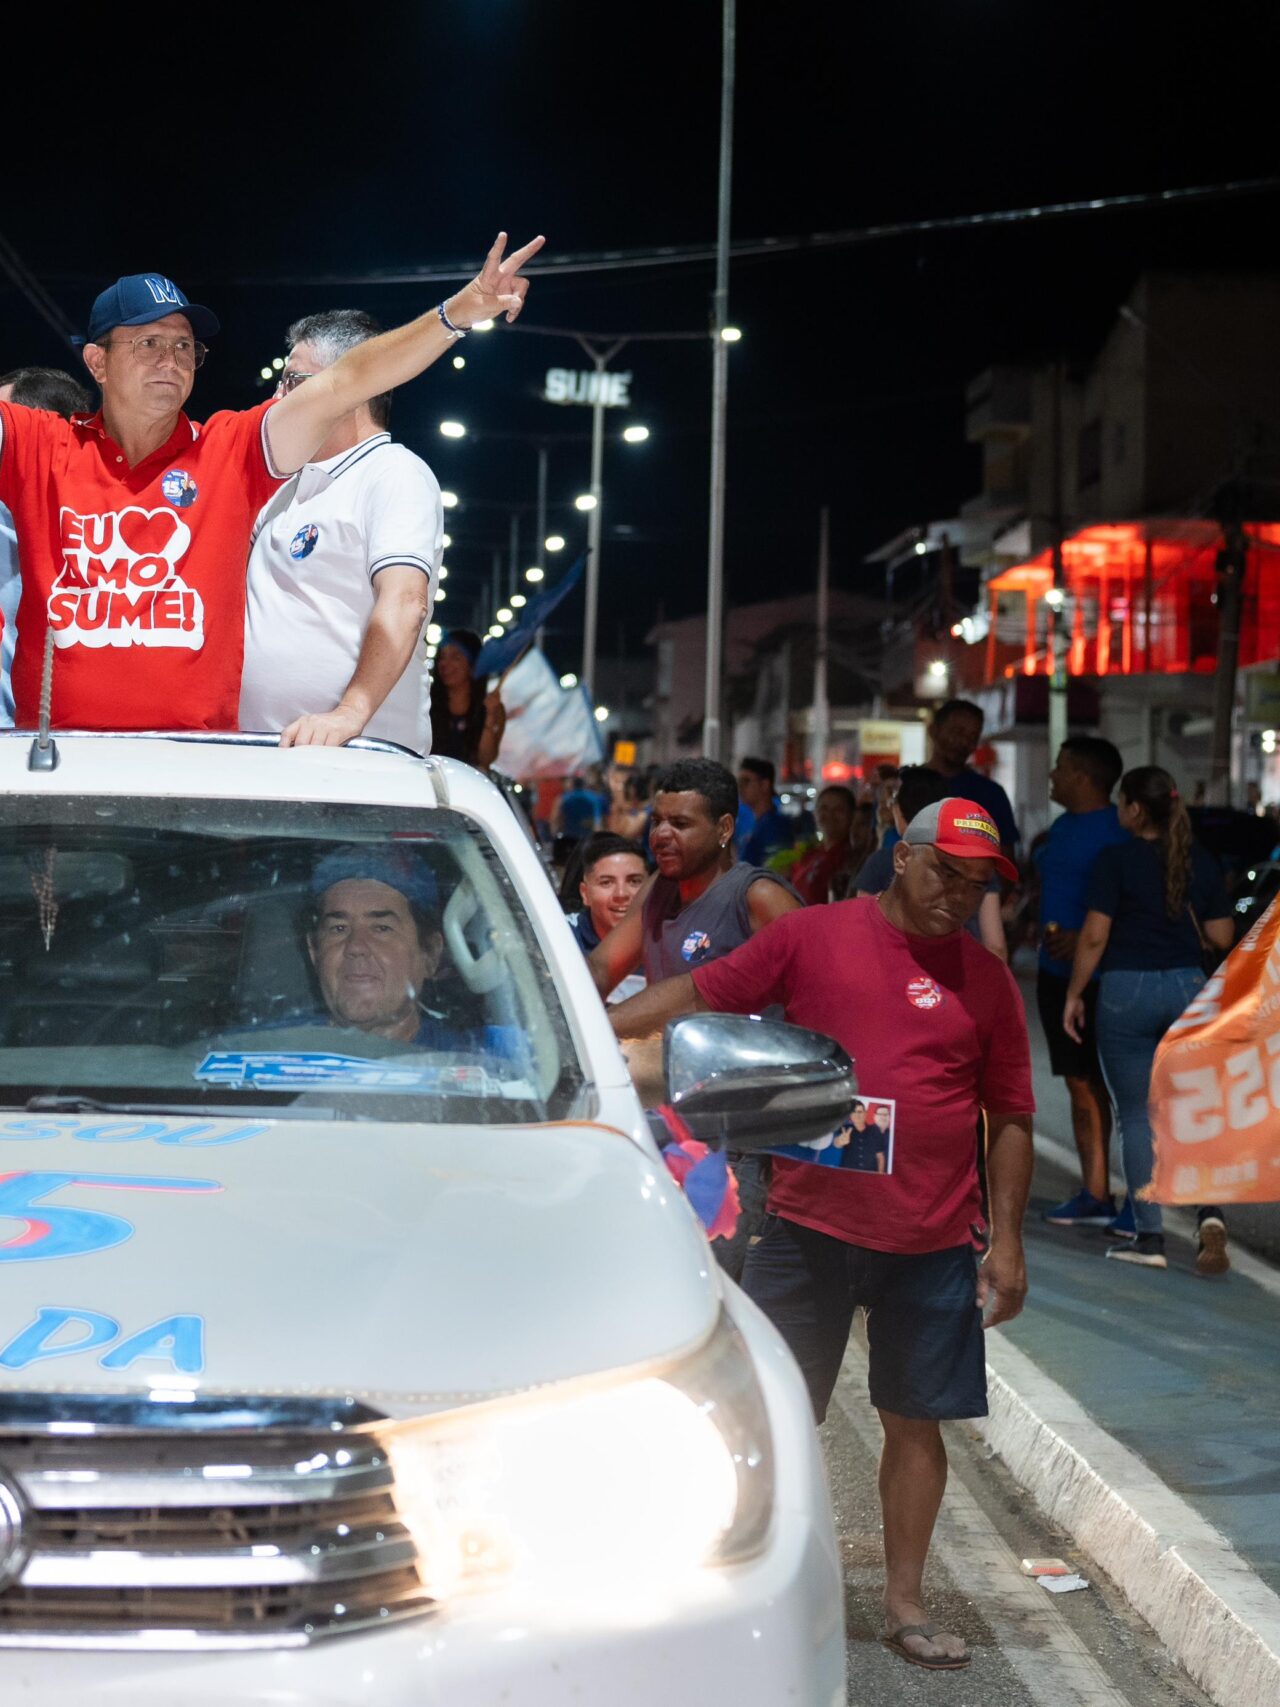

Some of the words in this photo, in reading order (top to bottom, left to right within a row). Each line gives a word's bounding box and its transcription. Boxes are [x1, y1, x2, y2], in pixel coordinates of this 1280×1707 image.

[61, 509, 114, 555] EU
[56, 554, 170, 589] AMO
[48, 578, 196, 632] SUMÉ!
